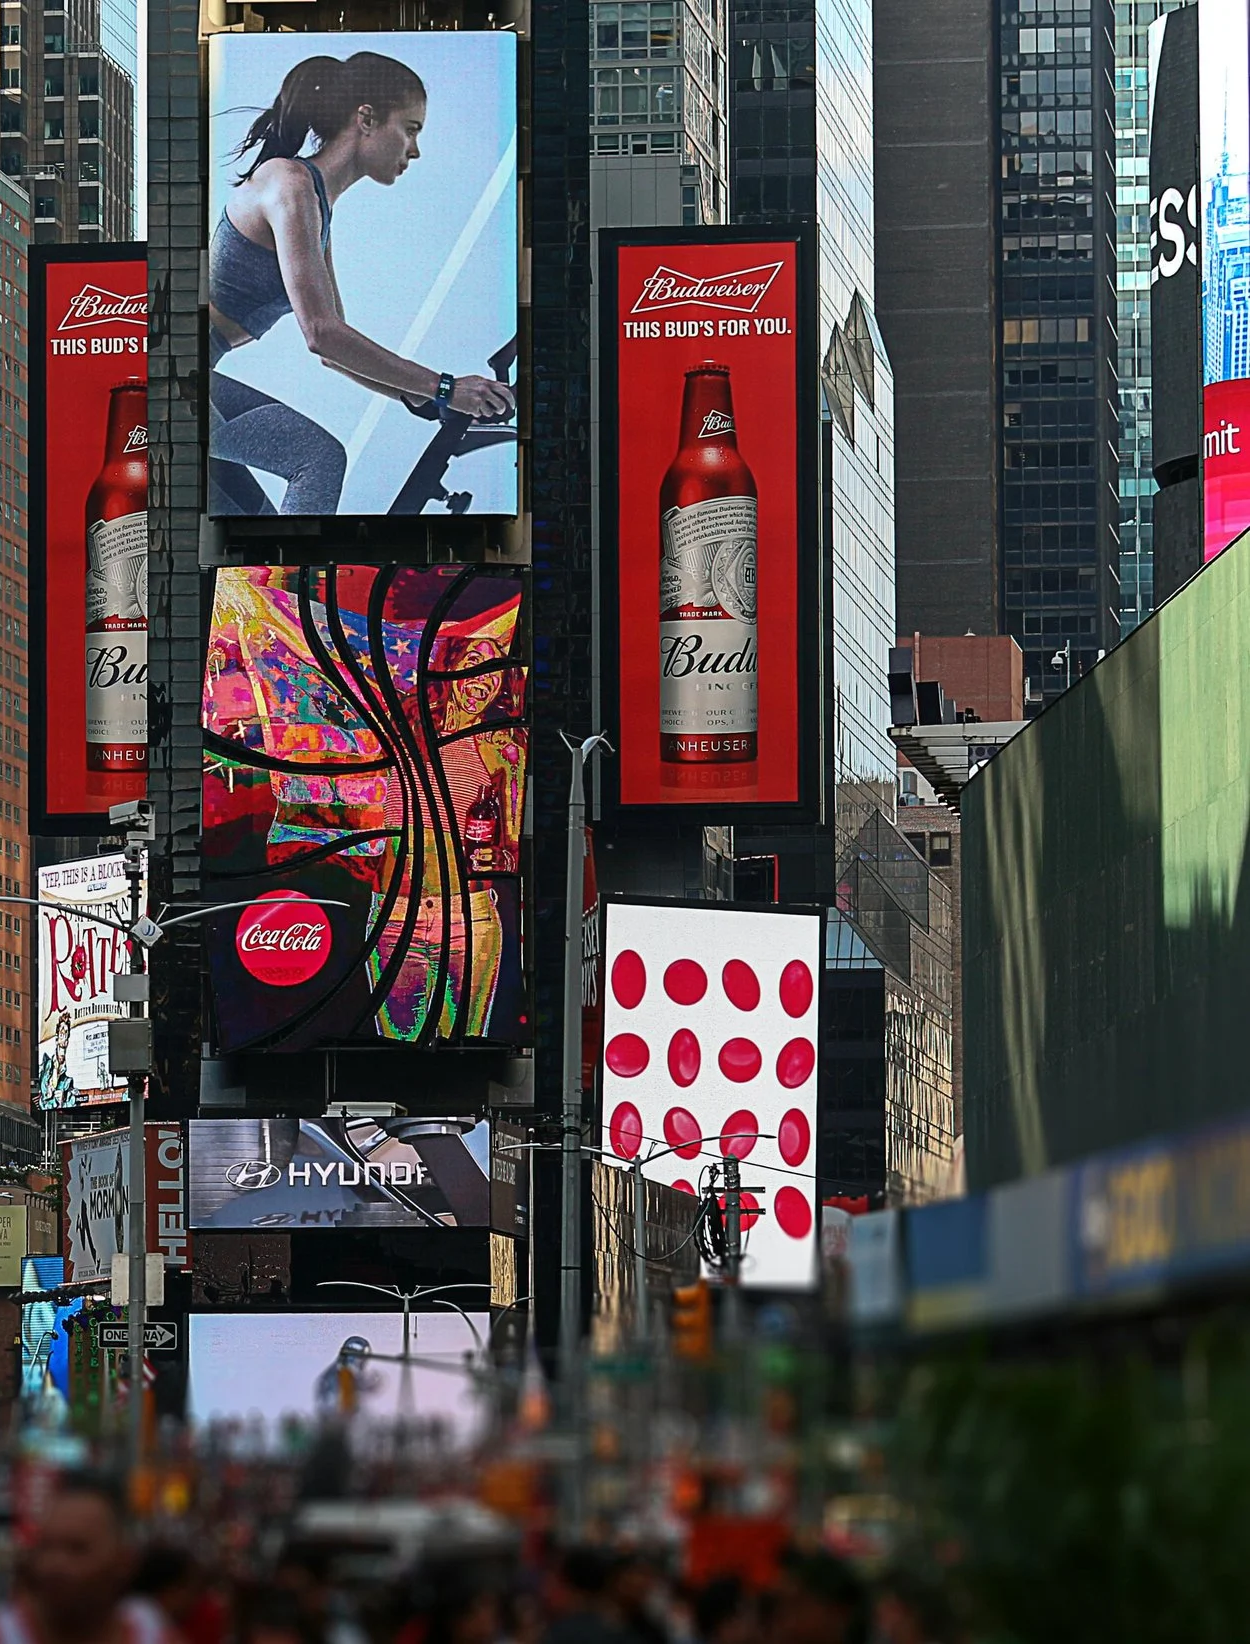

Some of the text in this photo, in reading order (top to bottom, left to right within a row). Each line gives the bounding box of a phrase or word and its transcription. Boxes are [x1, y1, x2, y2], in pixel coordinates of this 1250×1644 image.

[643, 277, 766, 301] Budweiser
[623, 318, 792, 338] THIS BUD'S FOR YOU.
[50, 338, 86, 355] THIS
[91, 337, 139, 354] BUD'S
[62, 865, 80, 885] THIS
[81, 866, 89, 882] IS
[241, 922, 326, 952] Coca-Cola
[90, 1185, 129, 1221] MORMN
[158, 1129, 187, 1264] HELLO!
[105, 1330, 166, 1341] ONE WAY
